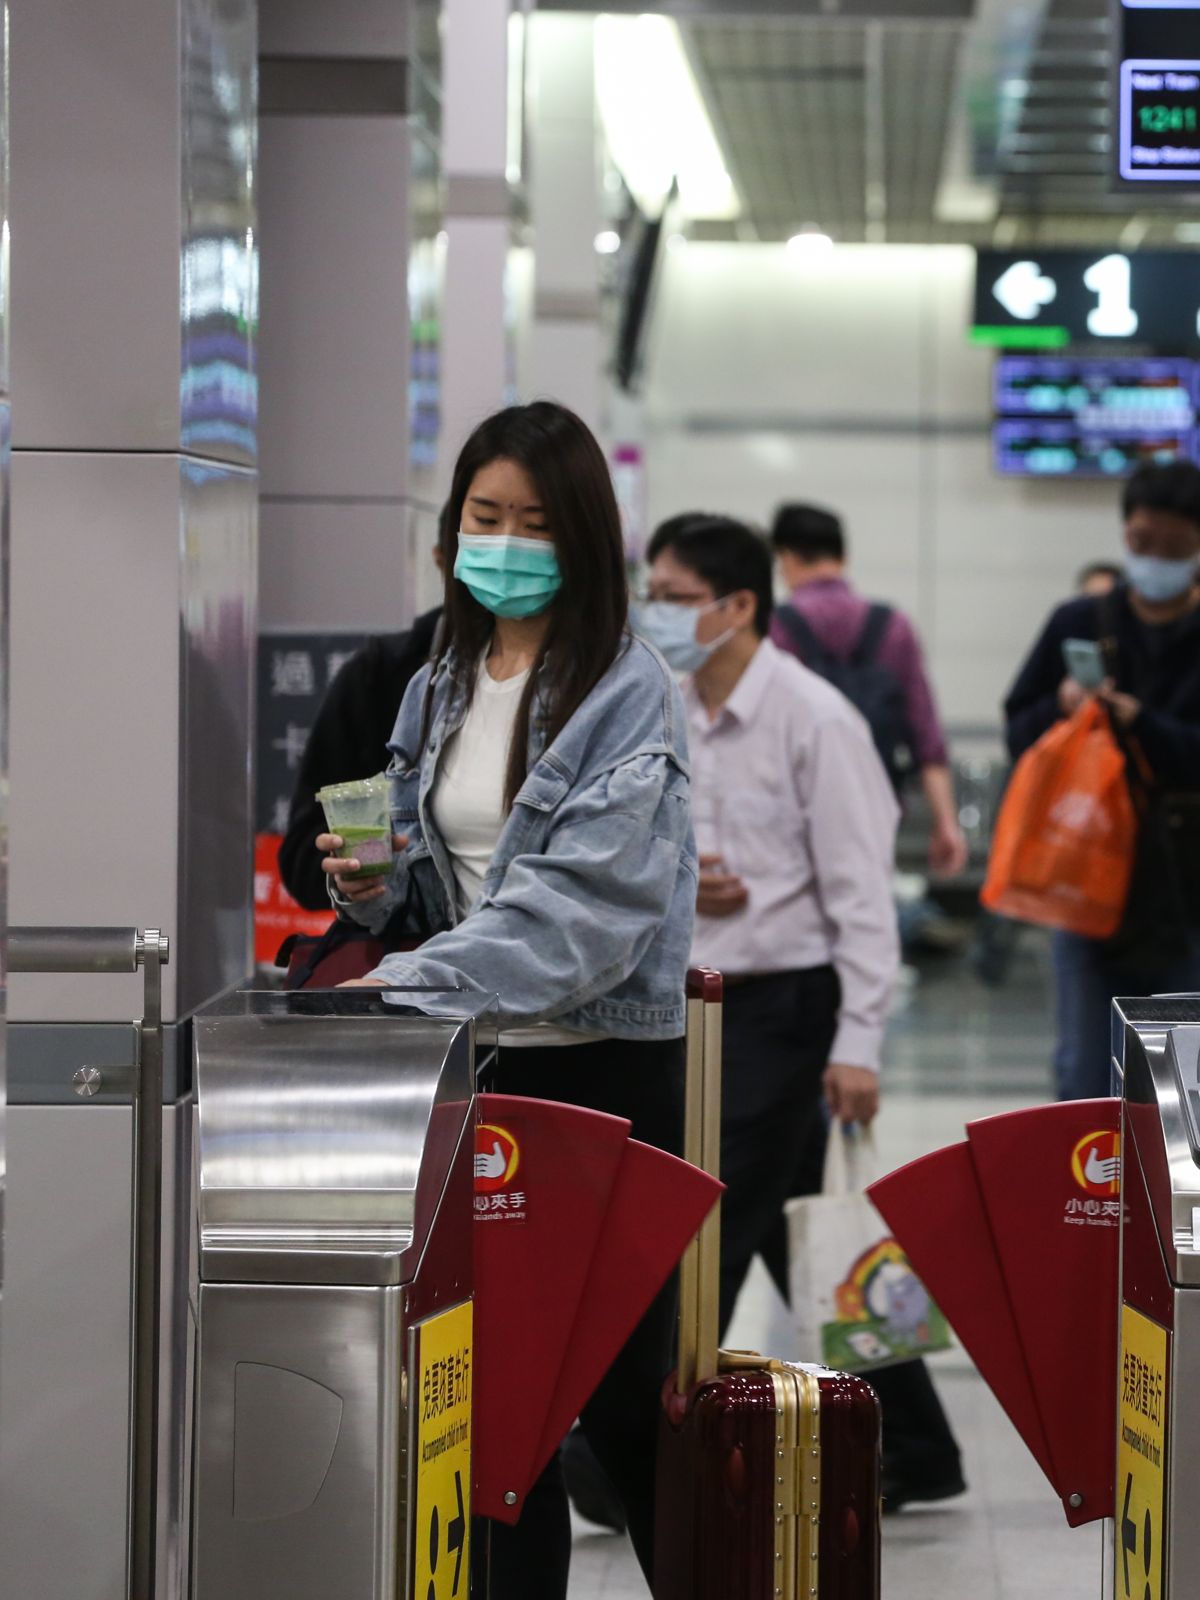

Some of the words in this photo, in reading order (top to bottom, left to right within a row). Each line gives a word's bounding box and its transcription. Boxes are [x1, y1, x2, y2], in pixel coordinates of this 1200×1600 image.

[1083, 254, 1139, 337] 1
[474, 1192, 526, 1210] 心夾手
[1064, 1198, 1120, 1217] 小心夾
